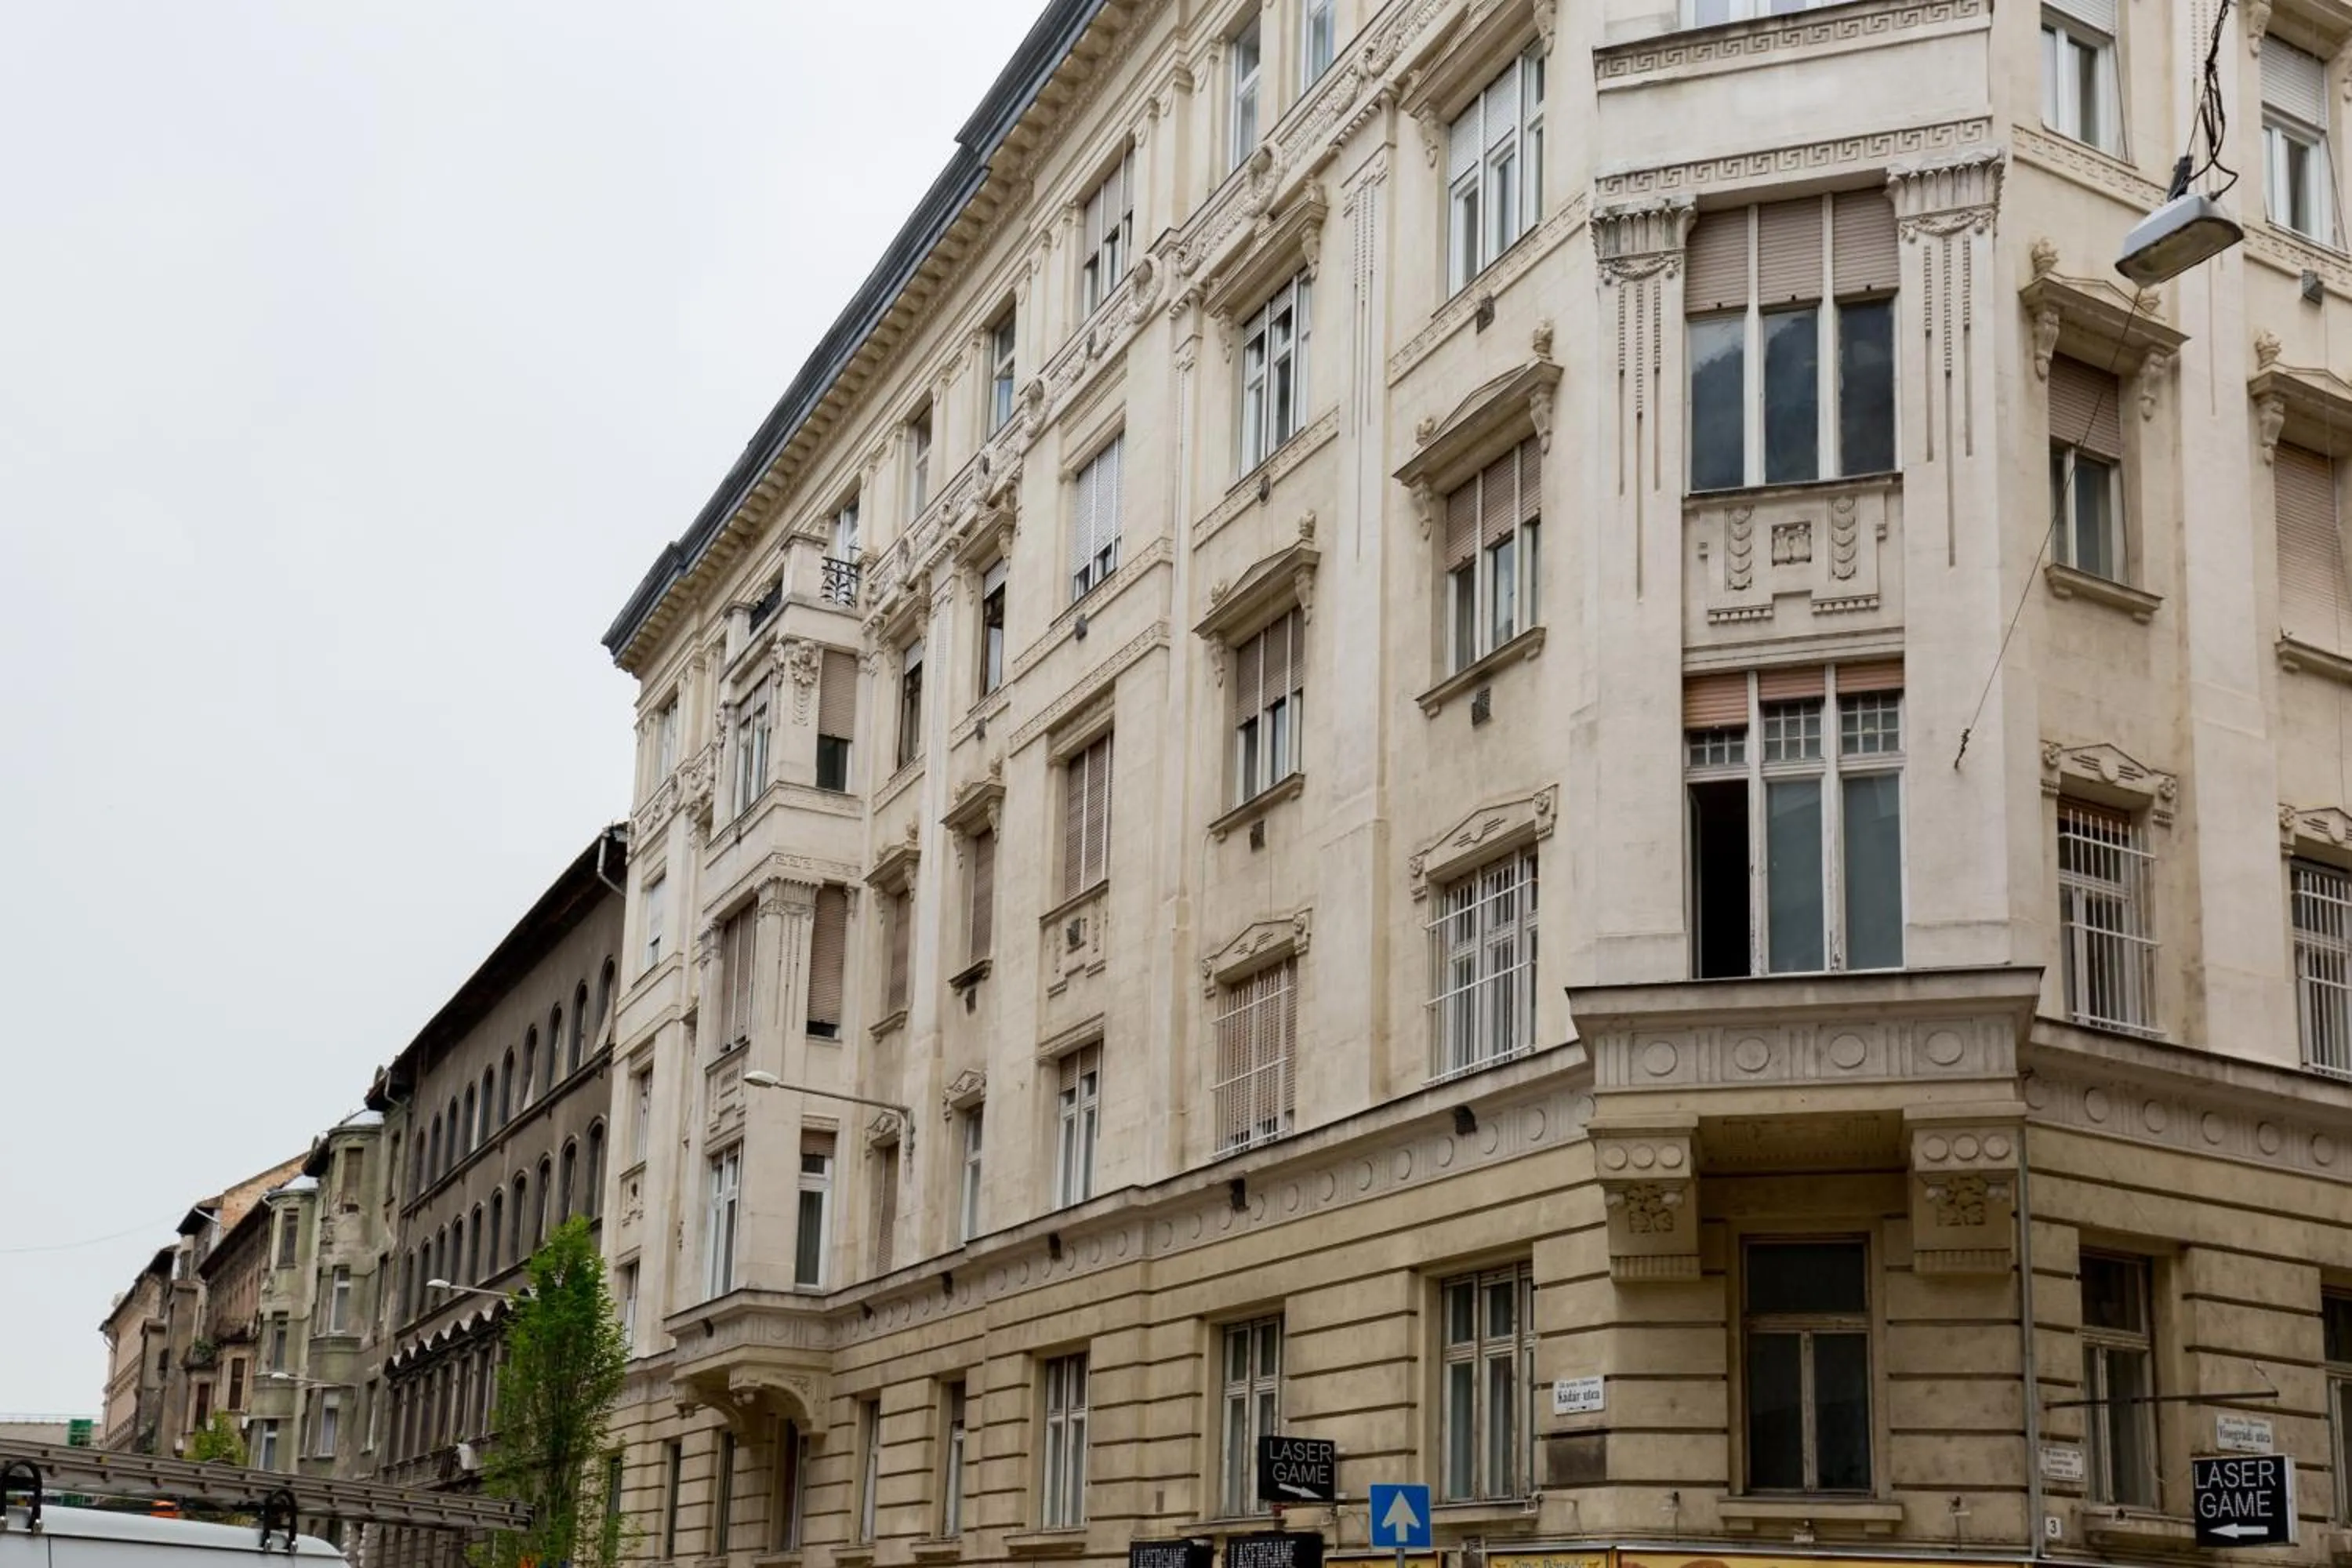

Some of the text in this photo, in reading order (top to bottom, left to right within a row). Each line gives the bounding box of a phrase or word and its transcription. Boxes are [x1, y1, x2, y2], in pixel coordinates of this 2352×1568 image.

[1558, 1389, 1600, 1403] Kádár utca
[1269, 1440, 1332, 1463] LASER
[1272, 1462, 1330, 1484] GAME
[2195, 1460, 2276, 1489] LASER
[2200, 1490, 2273, 1518] GAME
[2050, 1519, 2057, 1534] 3
[1230, 1541, 1297, 1568] LASERGAME
